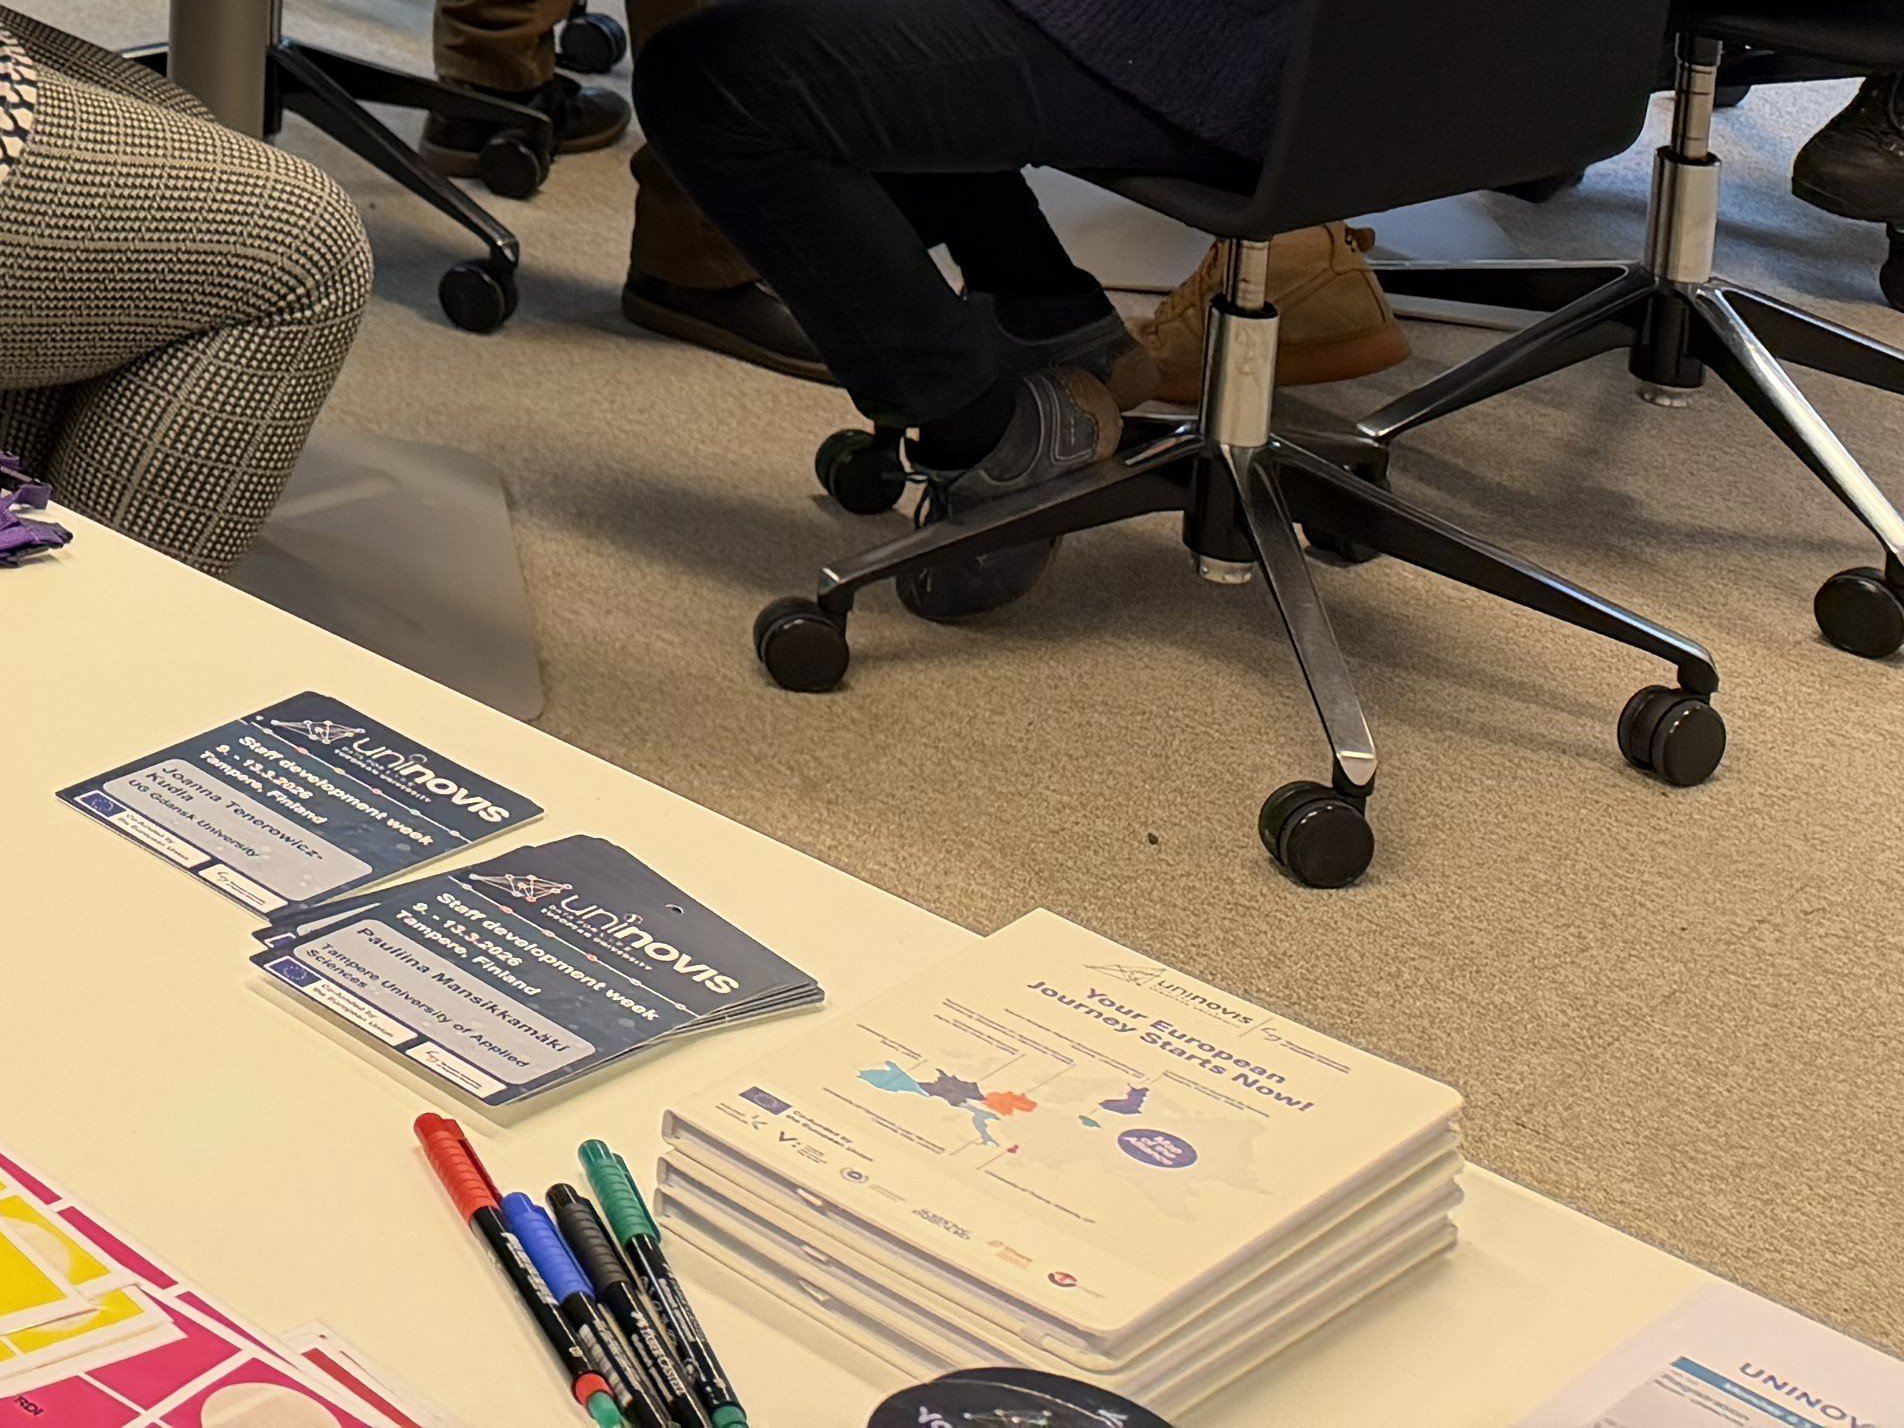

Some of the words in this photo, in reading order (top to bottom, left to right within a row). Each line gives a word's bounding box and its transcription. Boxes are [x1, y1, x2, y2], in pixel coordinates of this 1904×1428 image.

[161, 767, 223, 803] Joanna
[199, 750, 264, 793] Tampere,
[265, 789, 329, 825] Finland
[238, 735, 285, 761] Staff
[278, 759, 388, 820] development
[386, 817, 434, 847] week
[242, 758, 314, 800] 13.3.2026
[343, 737, 510, 823] uninovis
[196, 819, 261, 858] University
[305, 948, 368, 989] Sciences
[395, 909, 468, 959] Tampere,
[471, 955, 542, 996] Finland
[436, 892, 487, 921] Staff
[482, 920, 607, 991] development
[605, 988, 660, 1022] week
[443, 919, 523, 967] 13.3.2026
[561, 895, 739, 994] uninovis
[321, 942, 381, 982] Tampere
[380, 979, 453, 1024] University
[451, 1022, 474, 1035] of
[468, 1033, 531, 1068] Applied
[356, 927, 431, 974] Pauliina
[431, 972, 570, 1053] Mansikkamäki
[1156, 979, 1254, 1025] uninovis
[1026, 980, 1137, 1034] Journey
[1139, 1031, 1227, 1076] Starts
[1230, 1072, 1314, 1113] Now!
[1086, 987, 1149, 1020] Your
[1149, 1019, 1286, 1085] European
[14, 1395, 44, 1416] RDI
